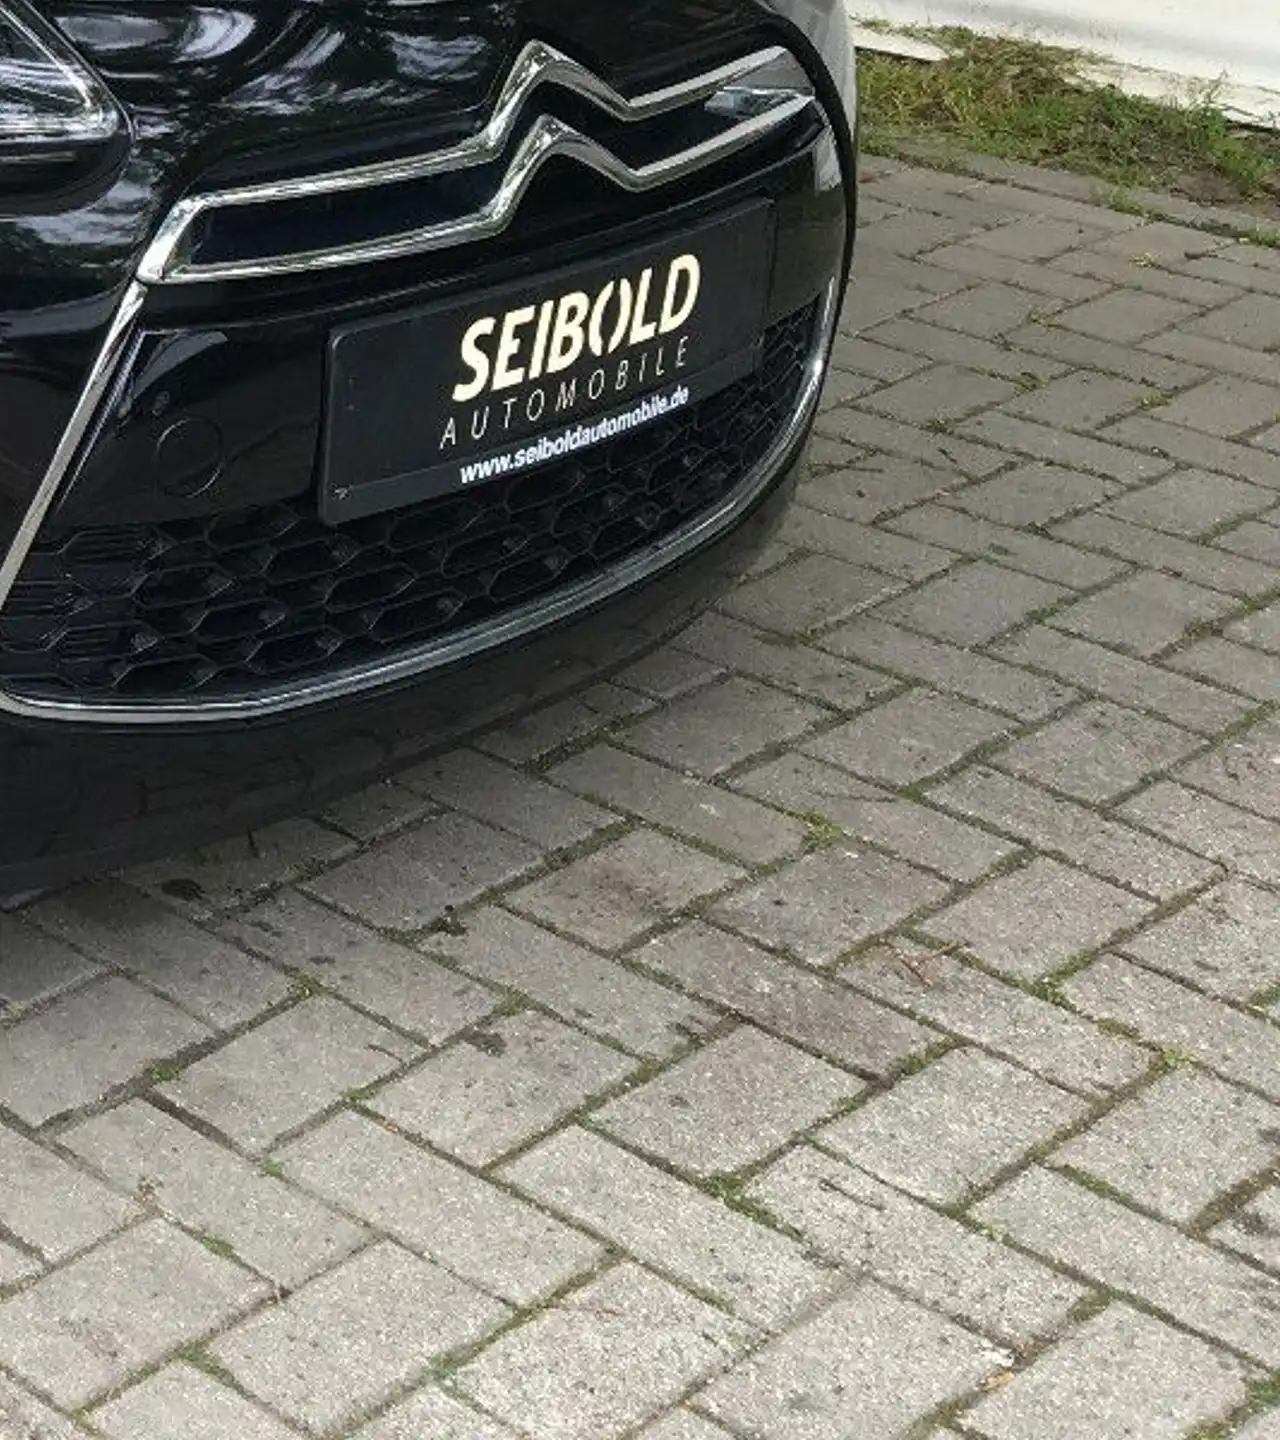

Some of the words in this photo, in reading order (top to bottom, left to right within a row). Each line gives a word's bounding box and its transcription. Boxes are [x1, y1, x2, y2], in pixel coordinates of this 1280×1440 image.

[451, 253, 701, 402] SEIBOLD
[439, 335, 690, 450] AUTOMOBILE
[459, 383, 690, 484] www.seiboldautomobile.de
